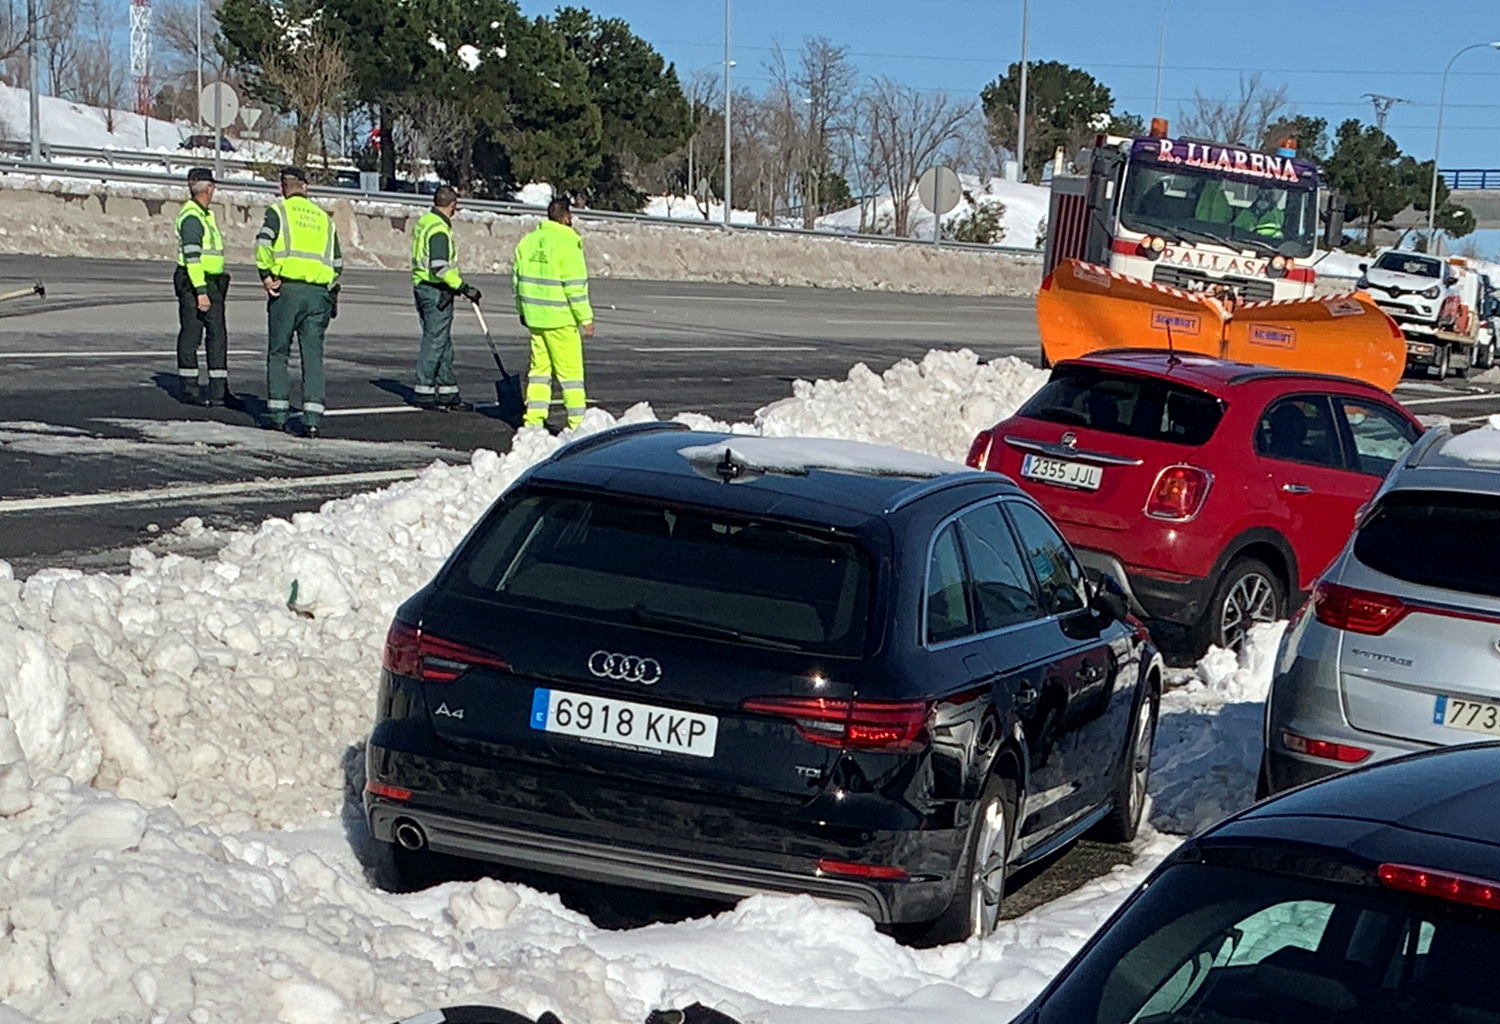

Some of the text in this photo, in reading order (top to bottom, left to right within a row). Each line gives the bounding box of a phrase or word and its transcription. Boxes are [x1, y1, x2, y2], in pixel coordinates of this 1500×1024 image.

[1158, 139, 1299, 182] R. LLARENA
[1162, 248, 1268, 278] RALLASA
[1031, 458, 1067, 479] 2355
[1070, 467, 1096, 486] JJL
[435, 702, 464, 719] A4
[535, 698, 706, 747] E 6918 KKP
[795, 765, 821, 778] TDI
